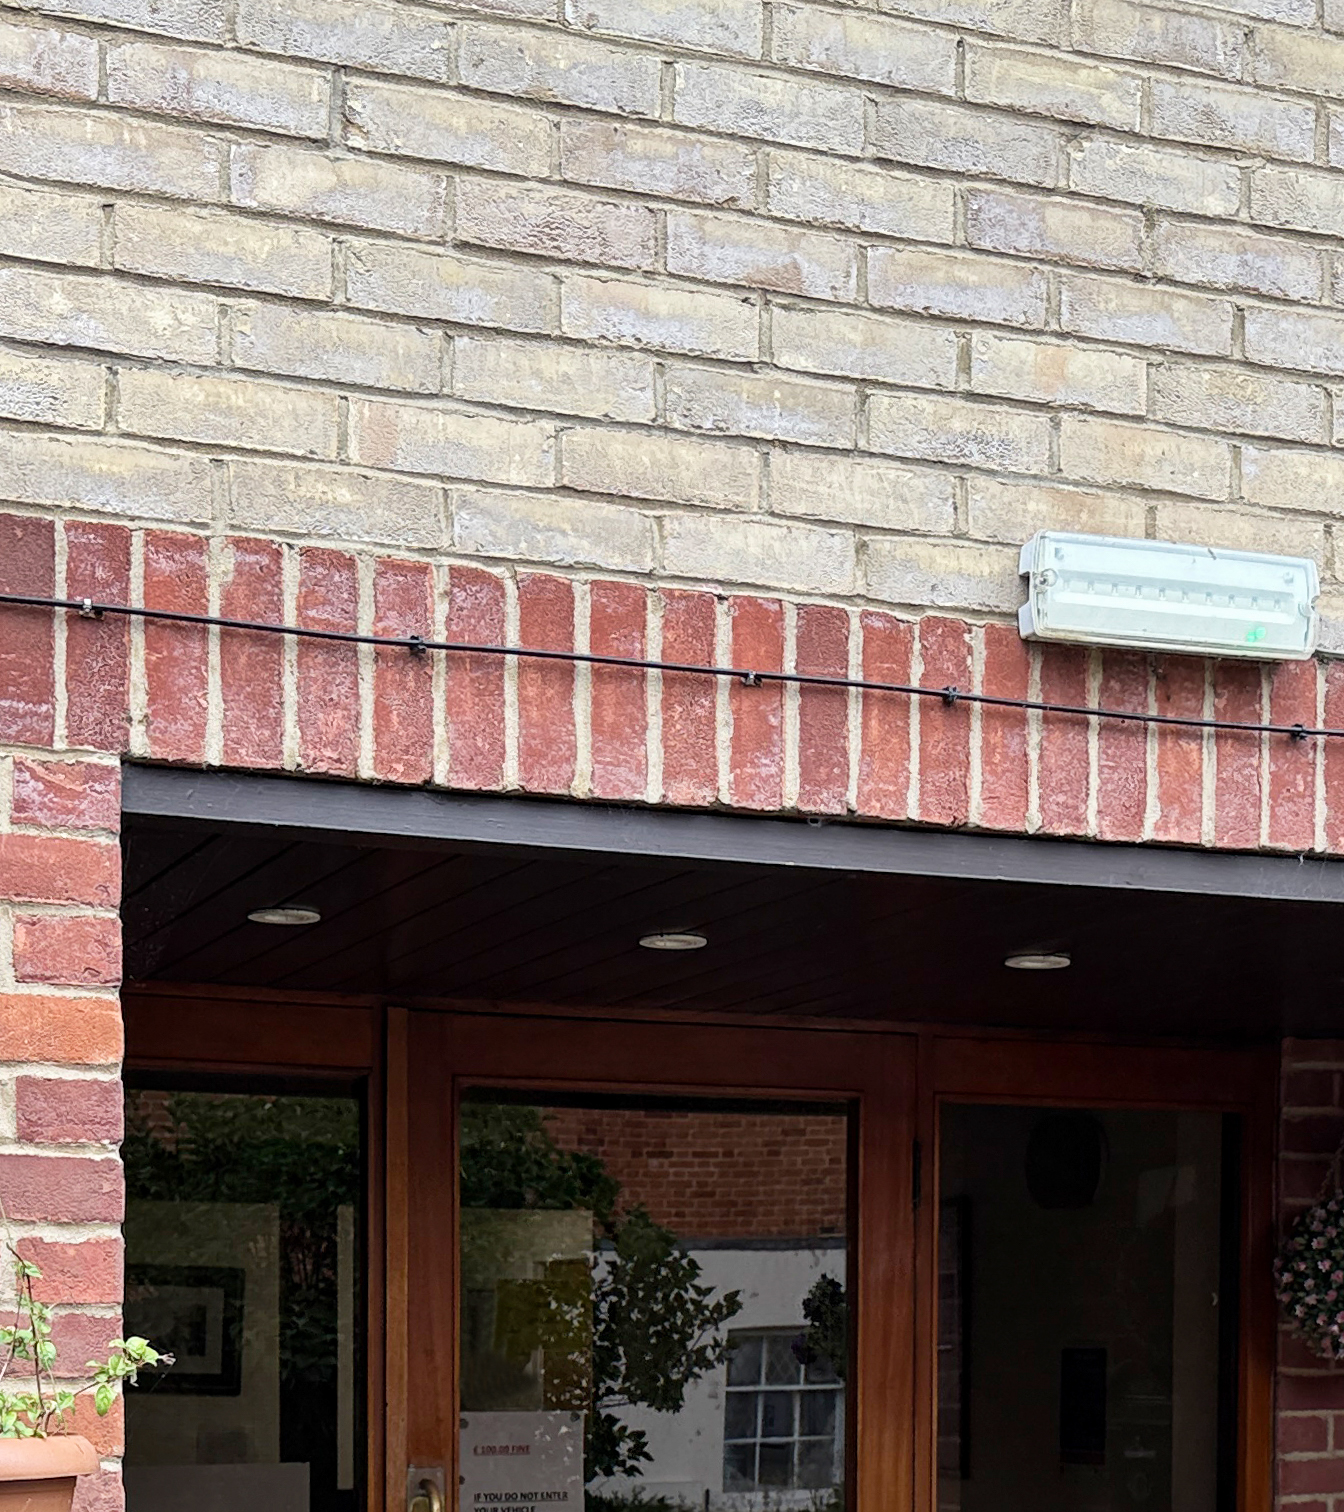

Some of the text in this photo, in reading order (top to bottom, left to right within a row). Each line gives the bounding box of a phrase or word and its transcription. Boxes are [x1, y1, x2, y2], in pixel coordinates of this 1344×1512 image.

[483, 1493, 503, 1502] YOU
[504, 1493, 518, 1501] DO
[520, 1492, 539, 1501] NOT
[540, 1491, 569, 1500] ENTER
